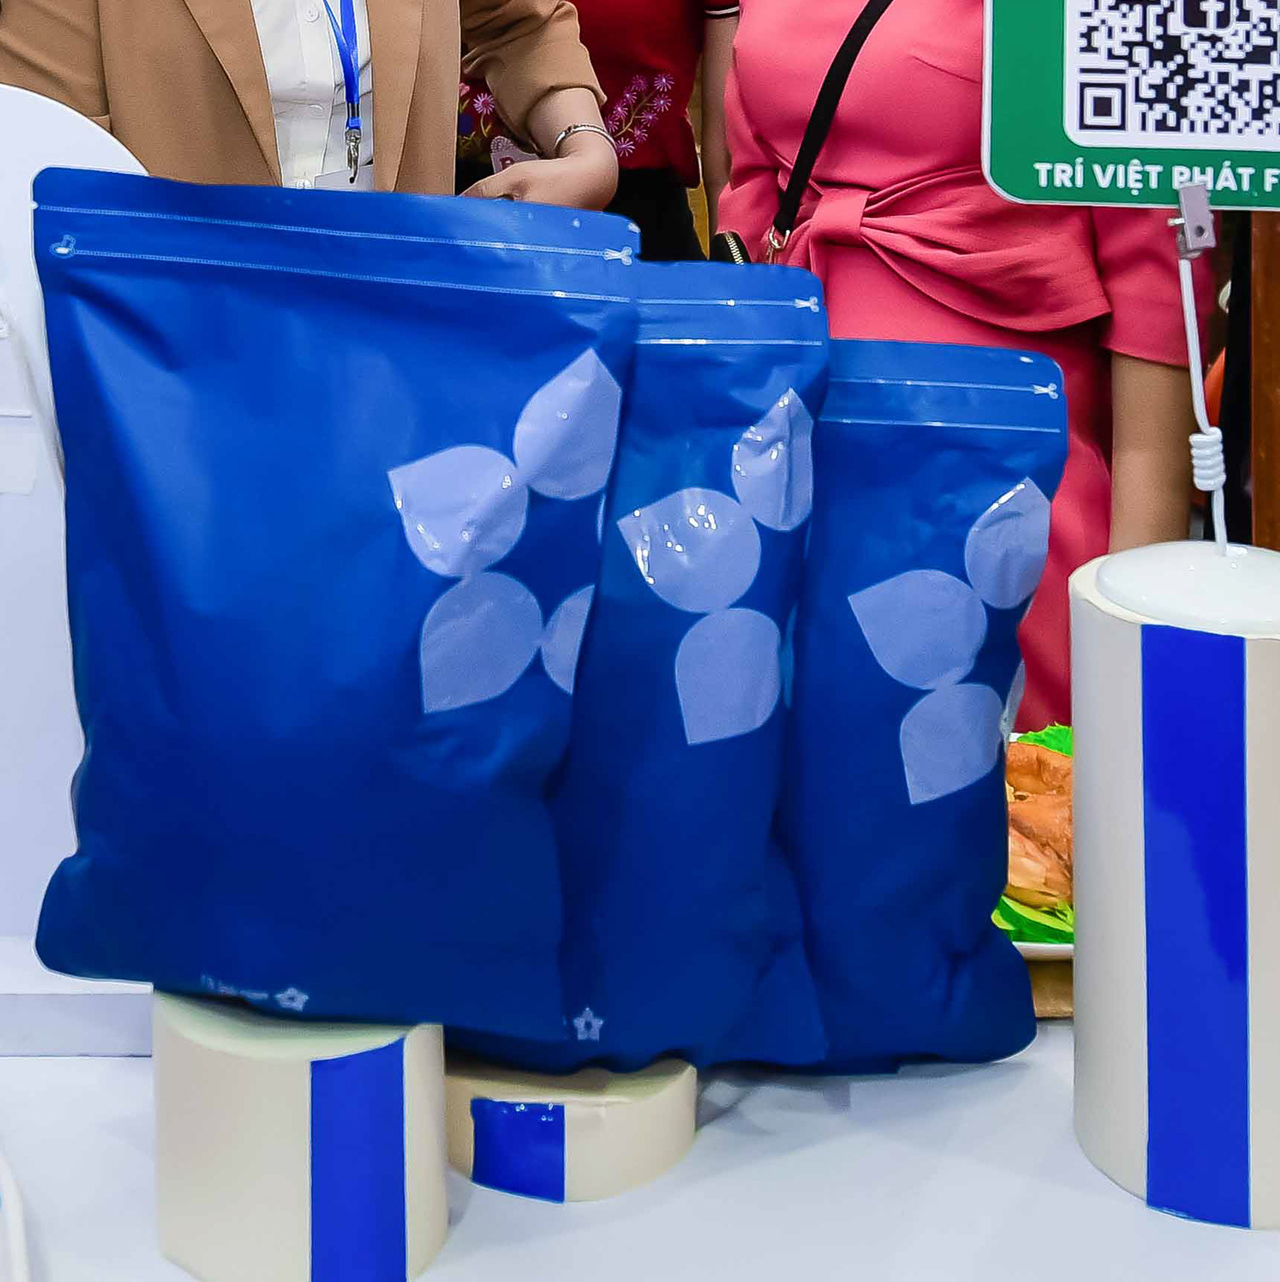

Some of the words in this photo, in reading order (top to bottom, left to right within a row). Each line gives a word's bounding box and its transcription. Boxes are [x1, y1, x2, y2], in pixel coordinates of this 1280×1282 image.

[1034, 158, 1084, 188] TRÍ
[1093, 159, 1162, 195] VIỆT
[1173, 162, 1255, 193] PHÁT
